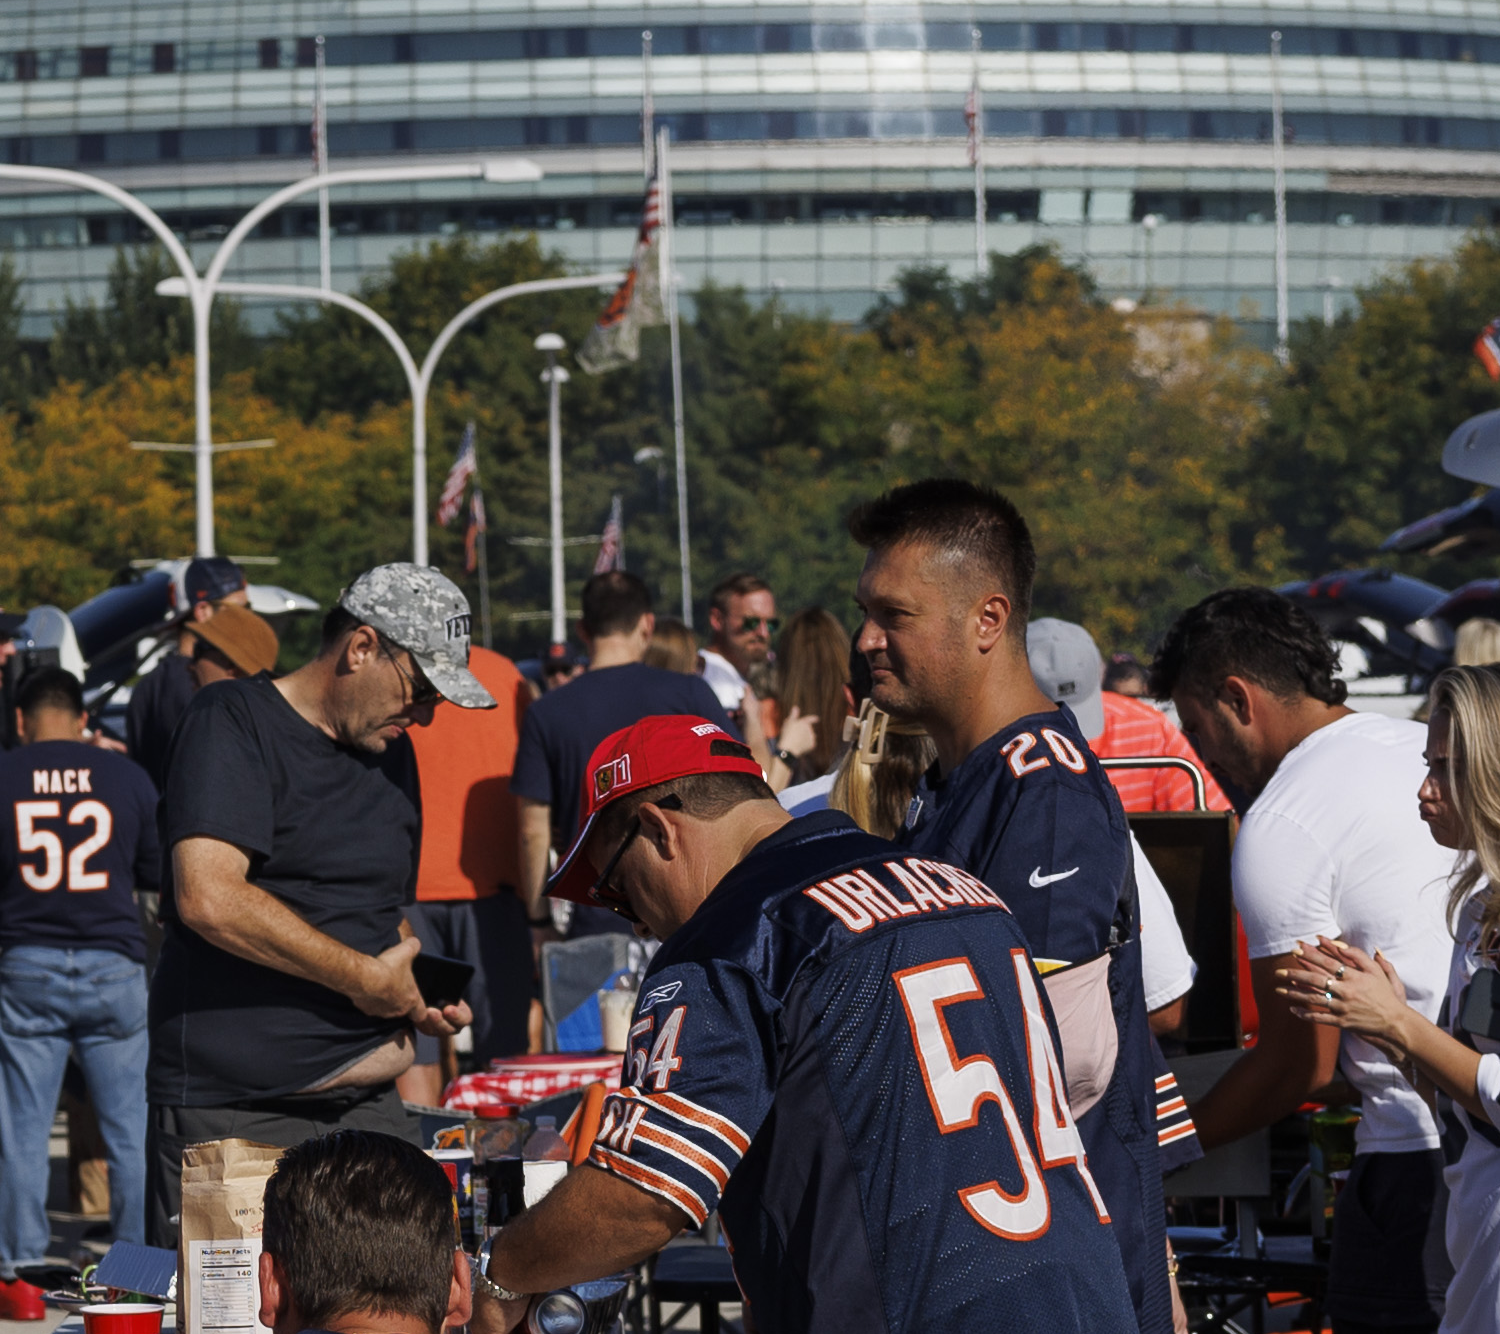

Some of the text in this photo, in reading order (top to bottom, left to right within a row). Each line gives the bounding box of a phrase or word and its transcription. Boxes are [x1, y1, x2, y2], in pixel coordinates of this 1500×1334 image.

[33, 768, 93, 794] MACK
[1000, 727, 1089, 779] 20
[13, 799, 113, 893] 52
[802, 857, 1013, 934] URLACHE
[626, 1005, 688, 1091] 54
[892, 948, 1113, 1243] 54
